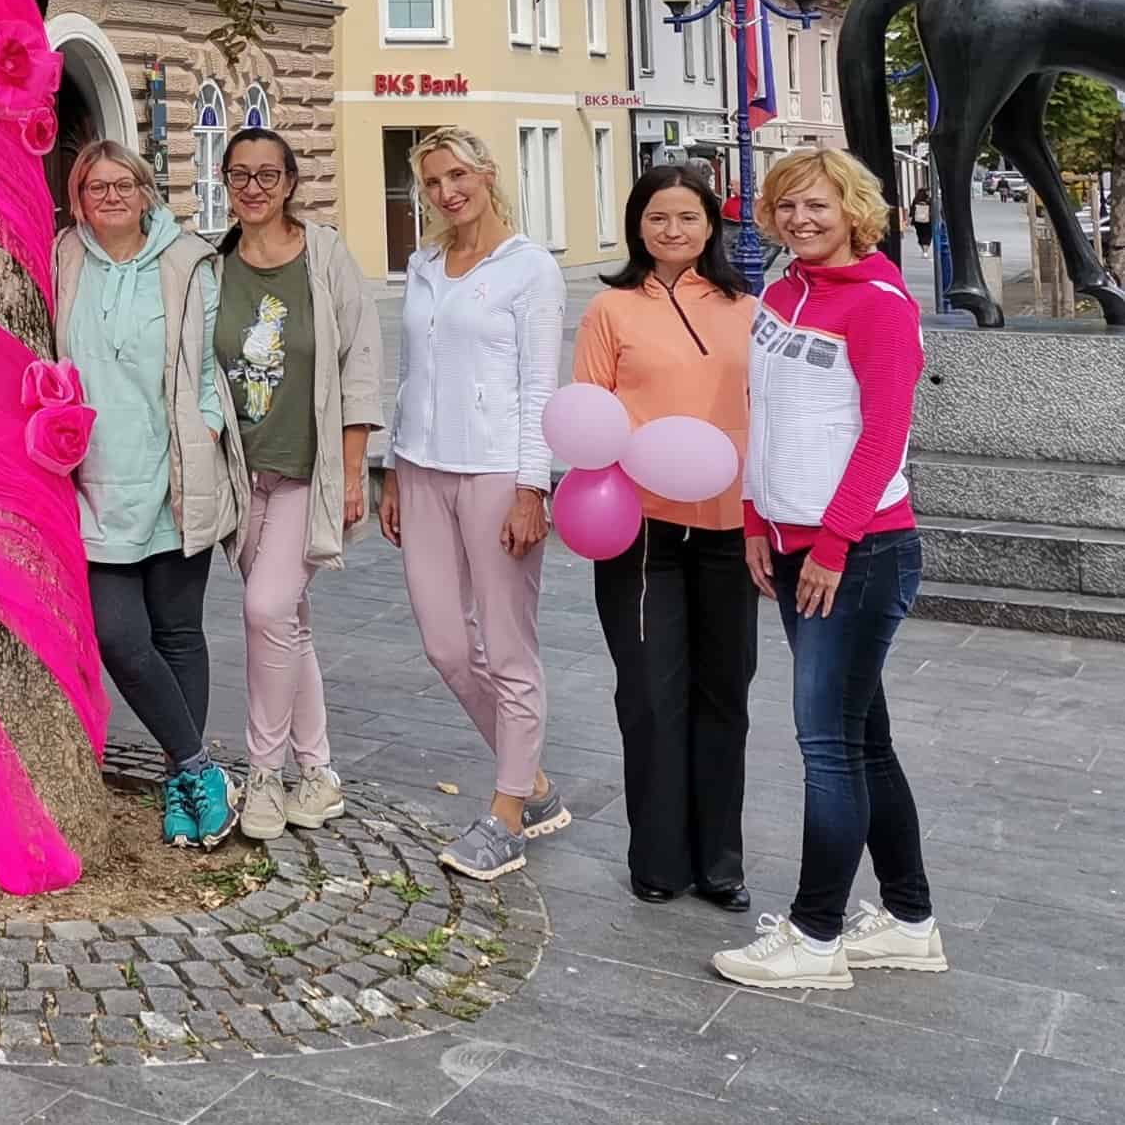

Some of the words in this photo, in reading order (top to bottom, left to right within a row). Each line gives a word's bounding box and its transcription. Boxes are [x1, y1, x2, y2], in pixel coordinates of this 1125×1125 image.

[374, 74, 415, 96] BKS
[419, 73, 470, 96] Bank
[584, 94, 609, 107] BKS
[611, 94, 641, 107] Bank
